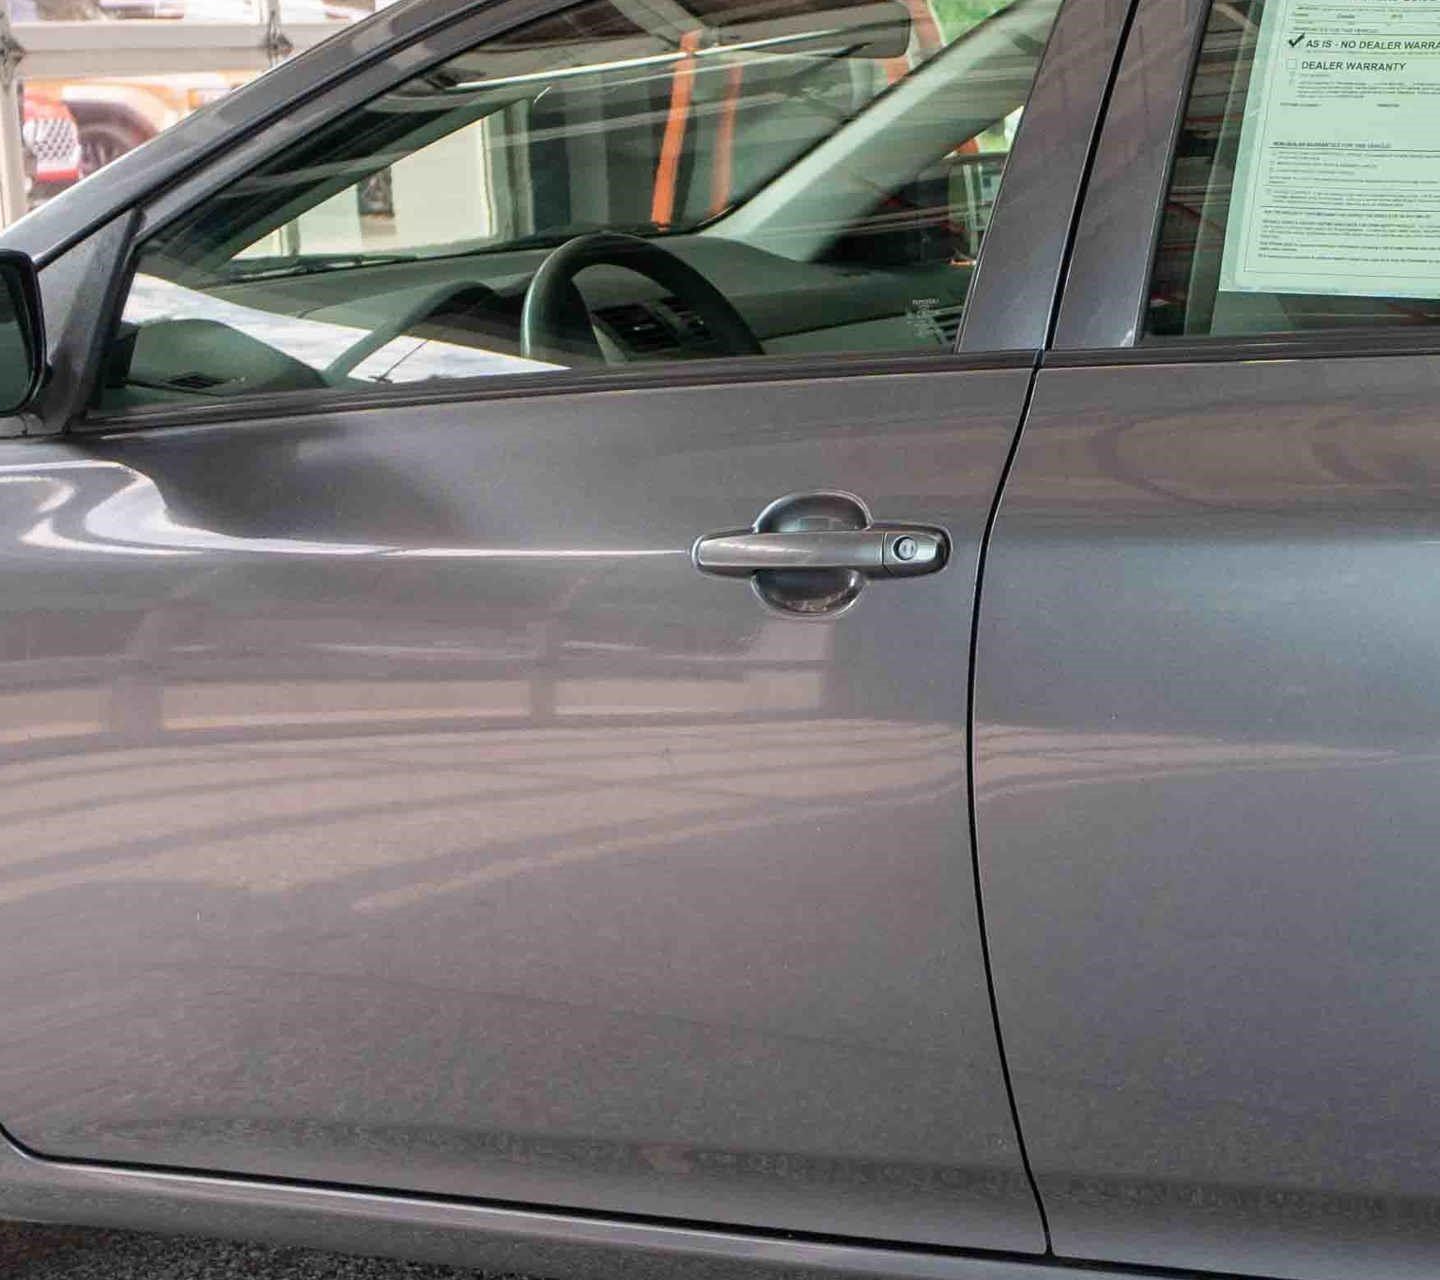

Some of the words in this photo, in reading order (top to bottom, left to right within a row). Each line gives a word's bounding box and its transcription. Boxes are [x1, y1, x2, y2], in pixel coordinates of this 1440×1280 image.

[1305, 39, 1320, 48] AS
[1322, 39, 1333, 49] IS
[1341, 40, 1356, 49] NO
[1358, 40, 1401, 50] DEALER
[1301, 61, 1343, 71] DEALER
[1346, 62, 1407, 72] WARRANTY
